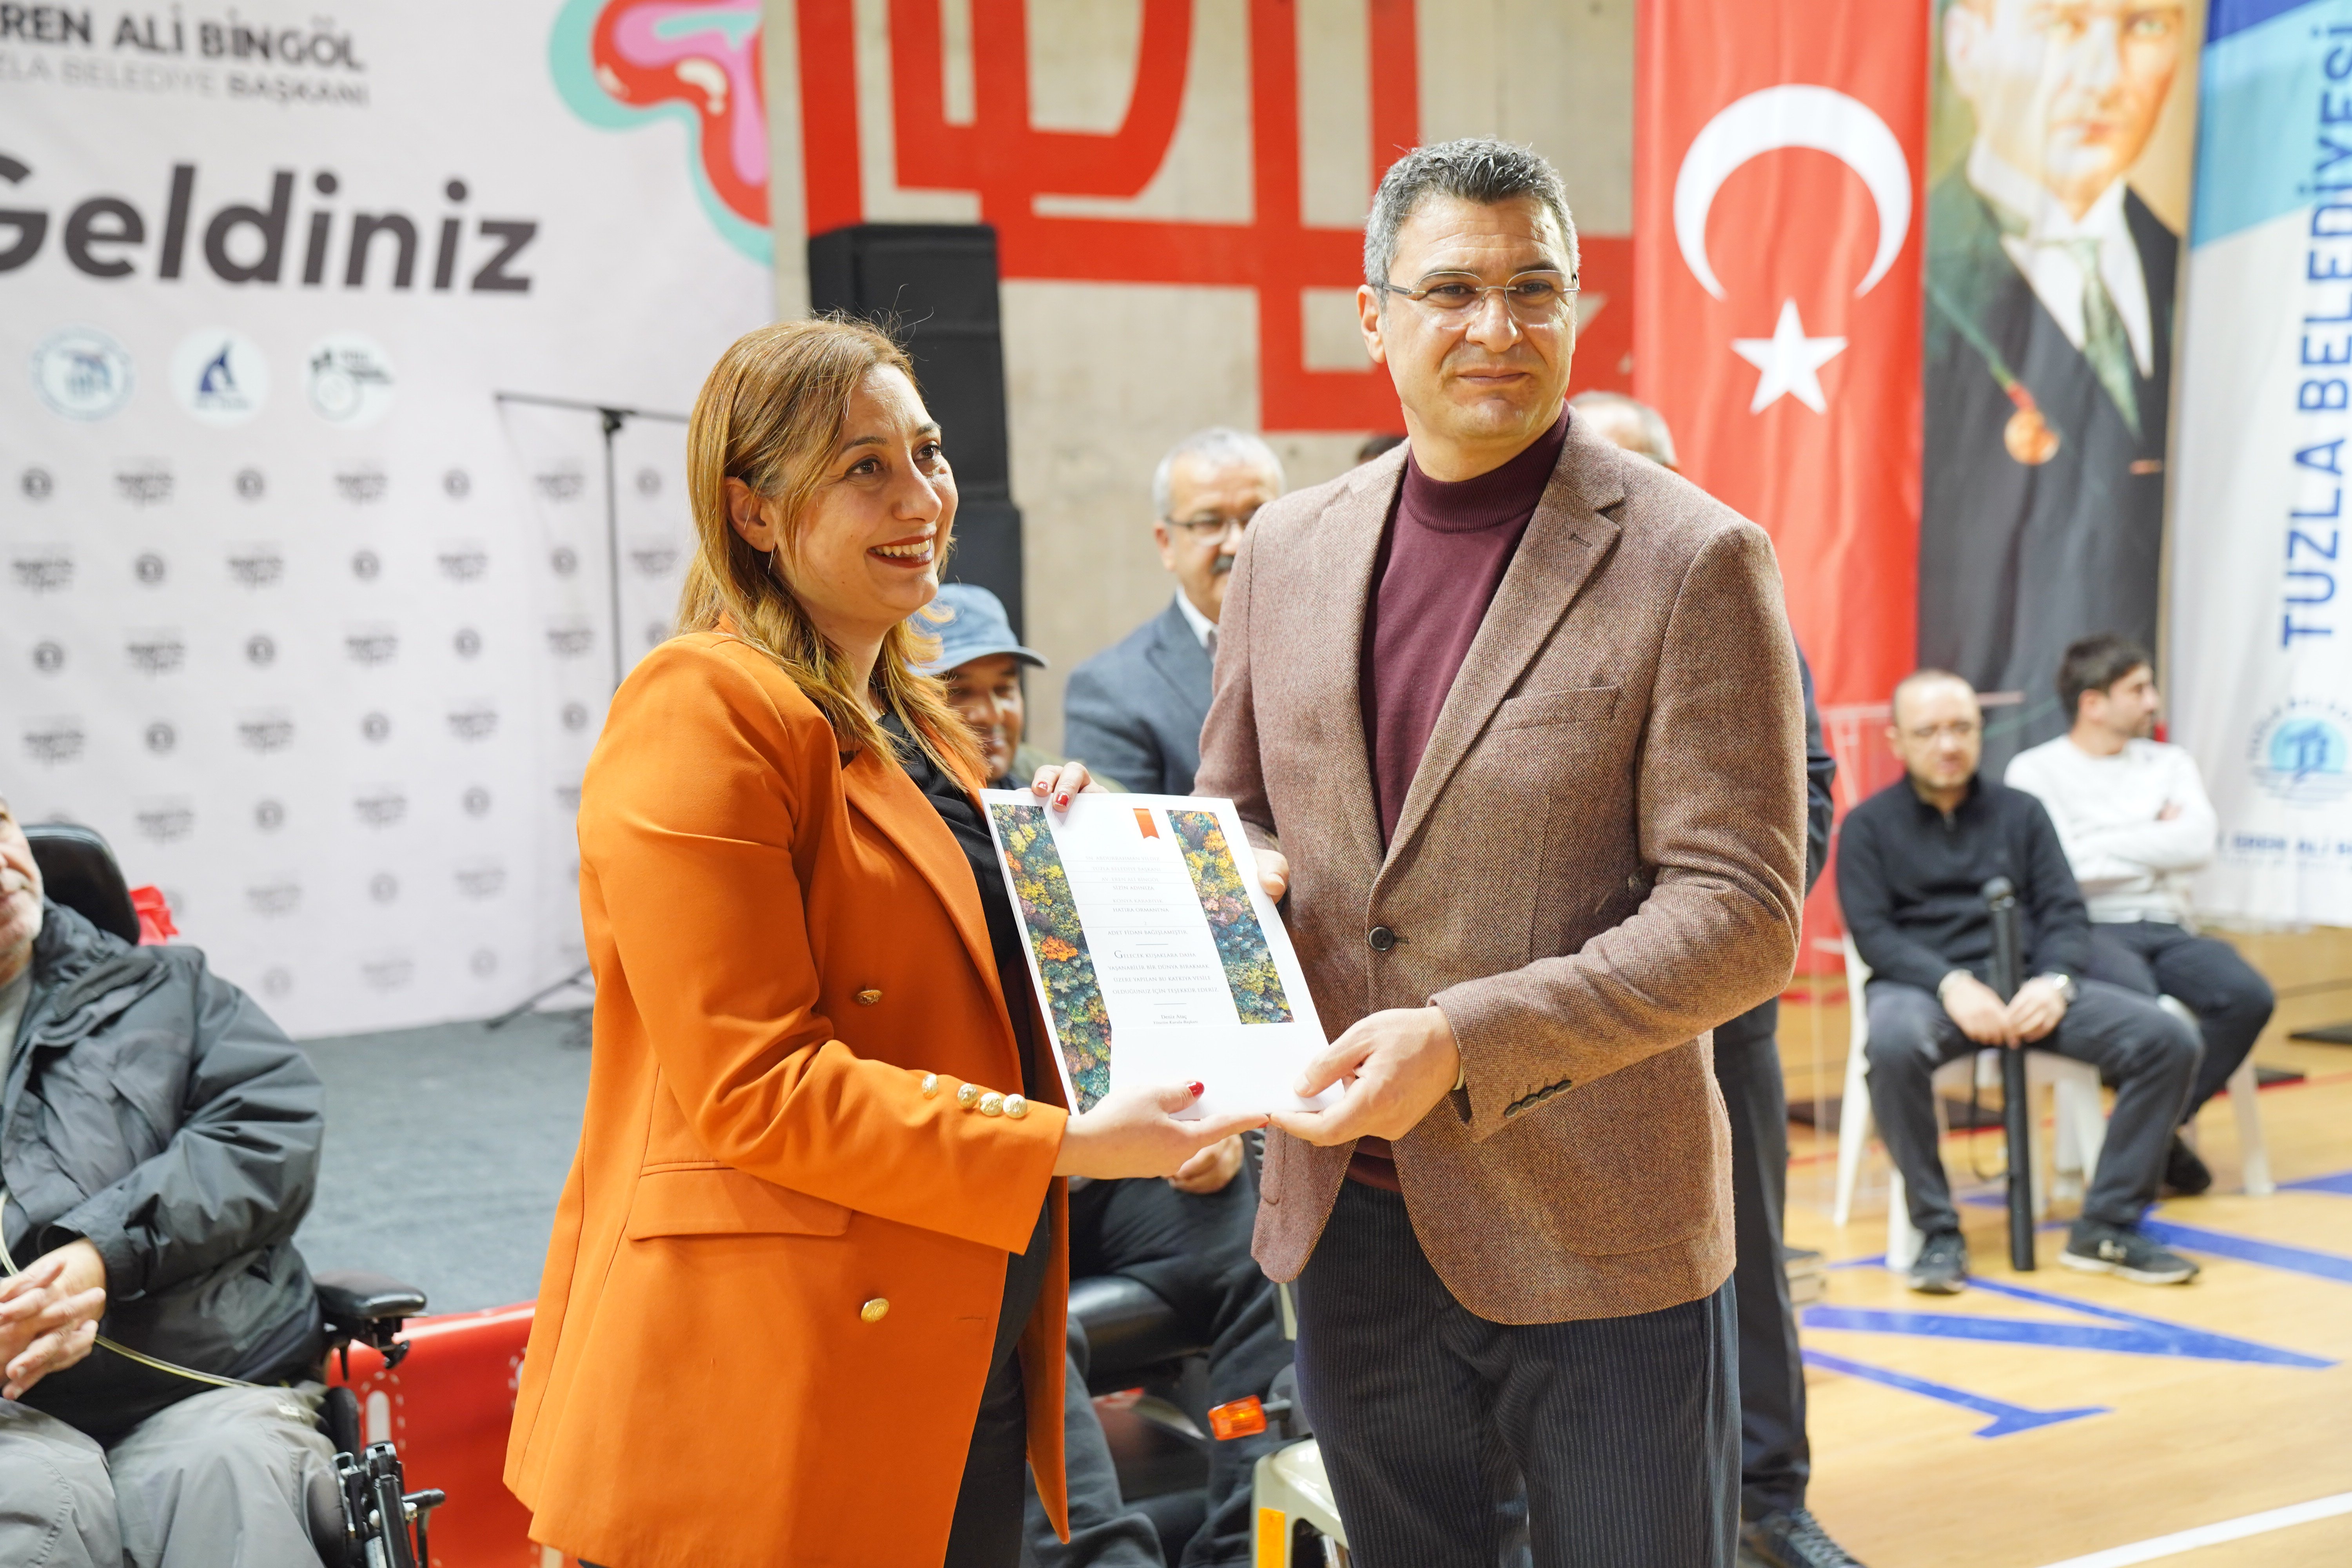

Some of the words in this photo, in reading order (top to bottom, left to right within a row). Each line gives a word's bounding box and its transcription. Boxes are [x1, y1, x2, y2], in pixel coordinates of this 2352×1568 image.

[113, 1, 184, 53] ALİ
[198, 5, 367, 71] BİNGÖL
[2283, 437, 2347, 648] TUZLA
